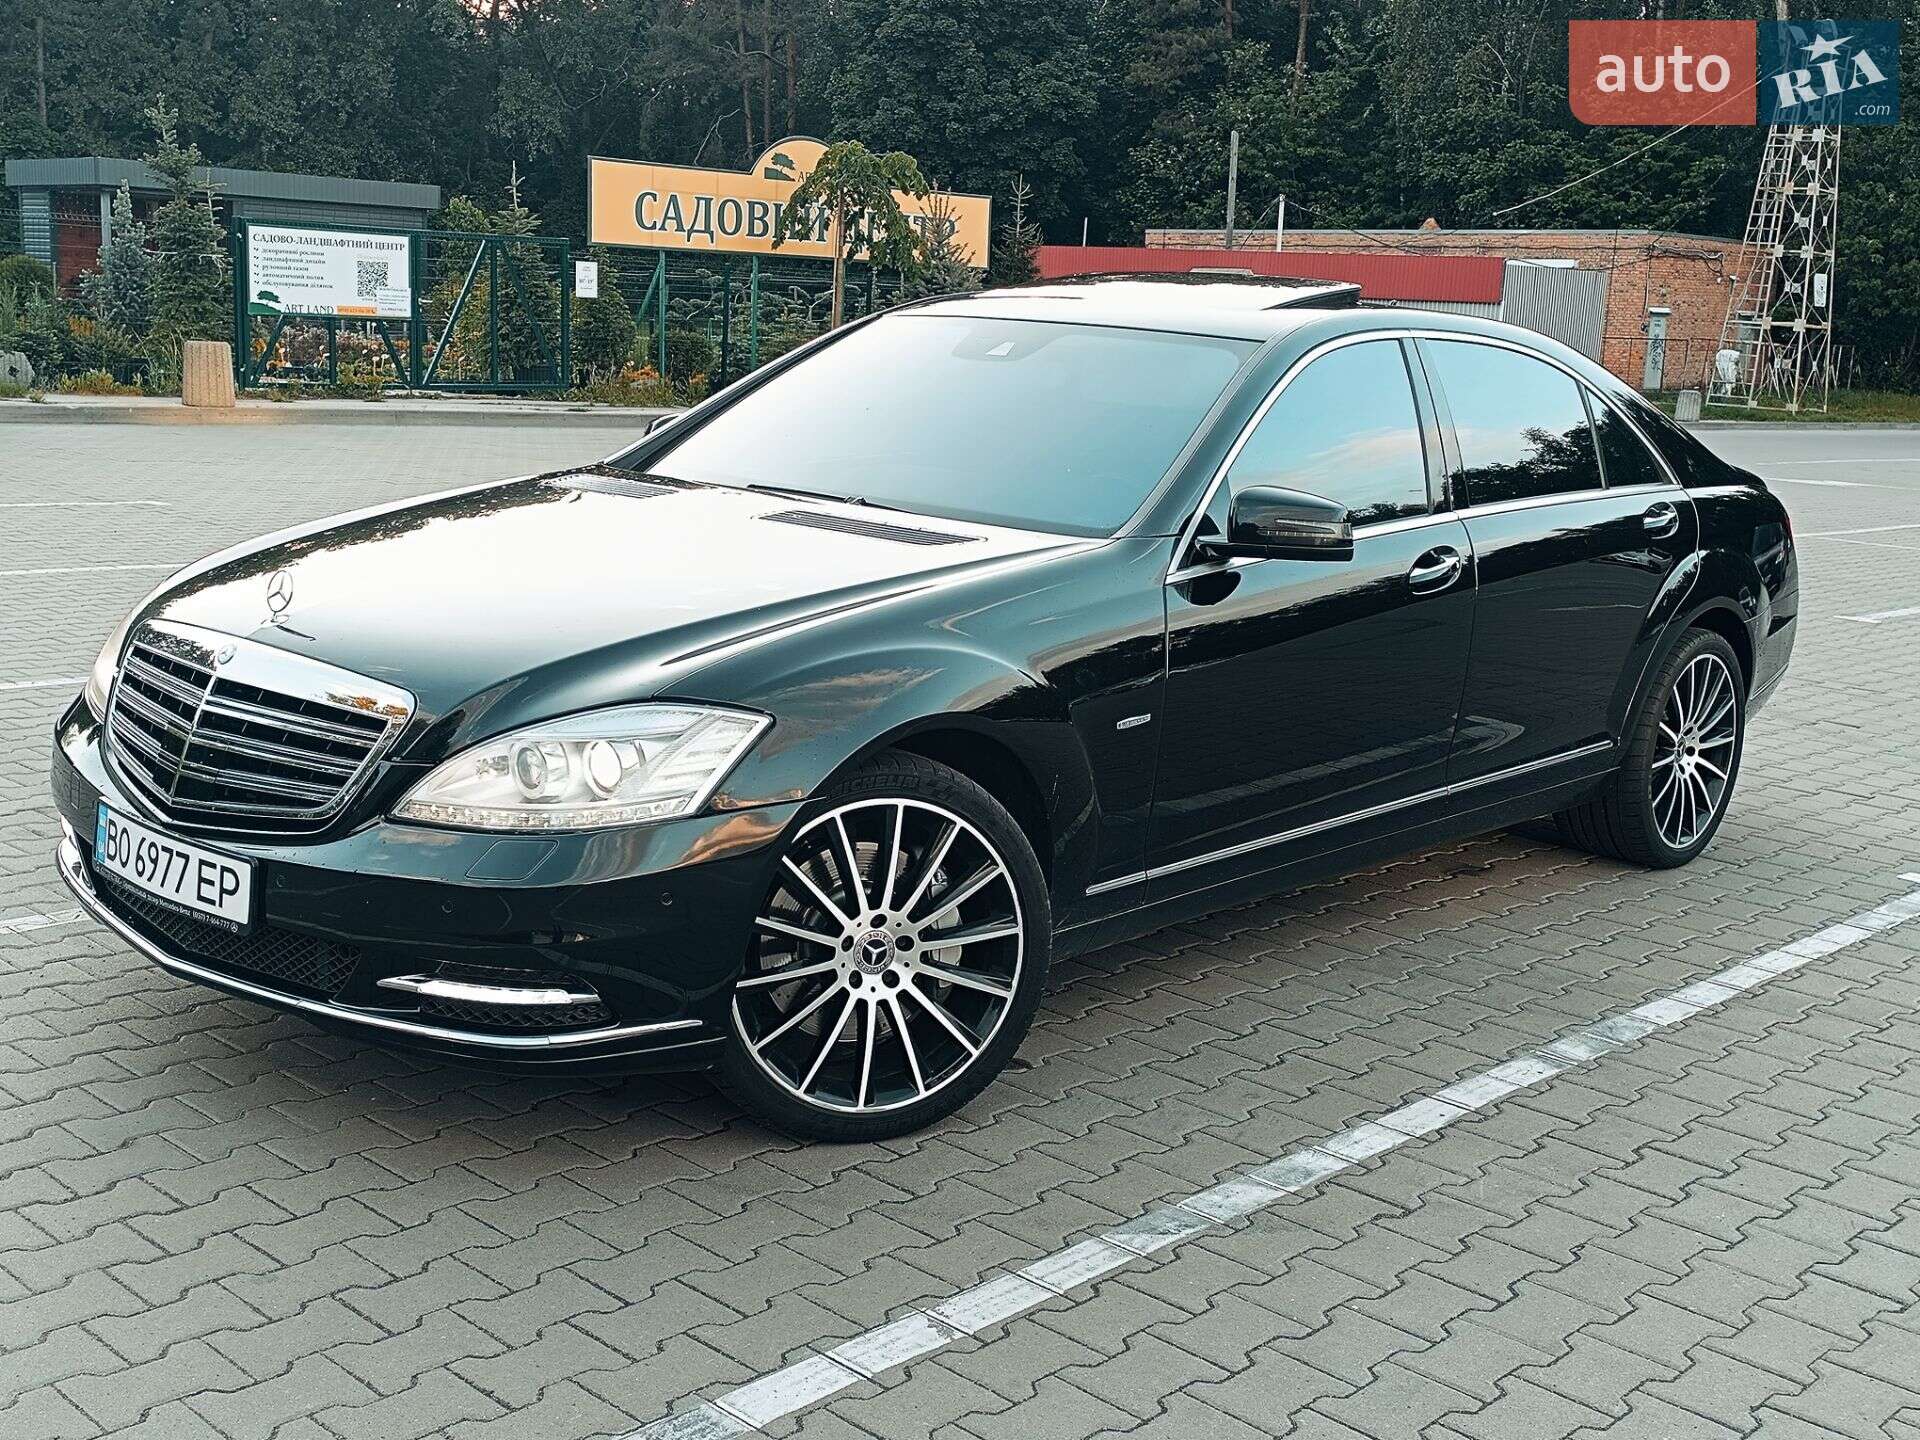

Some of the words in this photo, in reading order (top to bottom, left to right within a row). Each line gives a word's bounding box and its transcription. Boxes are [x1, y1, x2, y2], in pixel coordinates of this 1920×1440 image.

[253, 233, 374, 250] САДОВО-ЛАНДШАФТНИЙ
[375, 242, 406, 252] ЦЕНТР
[284, 303, 305, 314] ART
[306, 304, 335, 315] LAND
[106, 818, 131, 869] BO
[135, 836, 190, 895] 6977
[196, 857, 240, 909] EP
